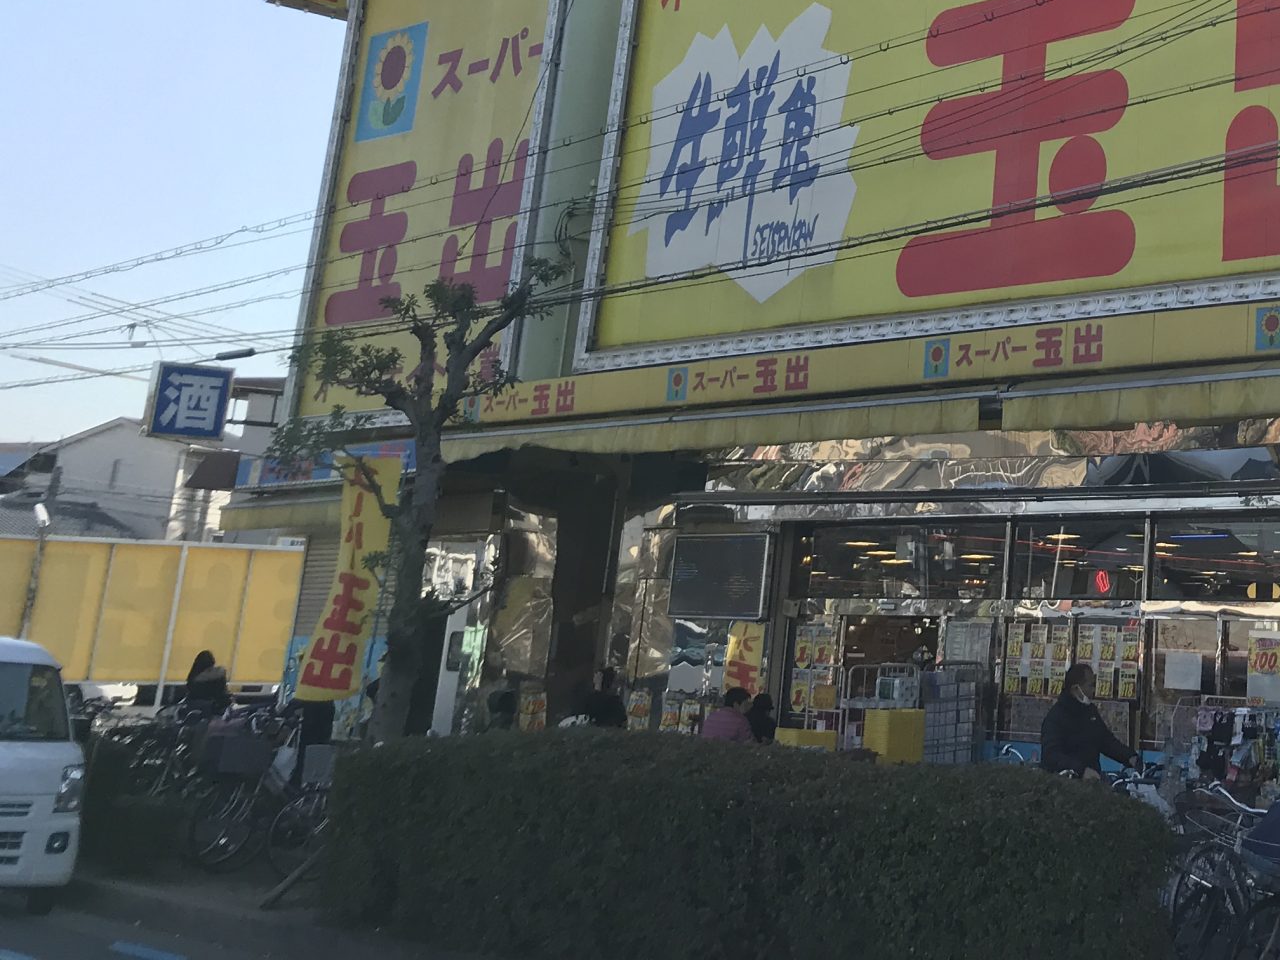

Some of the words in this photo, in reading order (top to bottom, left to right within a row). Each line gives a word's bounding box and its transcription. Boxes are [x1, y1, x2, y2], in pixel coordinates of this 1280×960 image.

[431, 26, 545, 100] スーパー
[325, 136, 531, 326] 玉出
[162, 371, 226, 432] 酒
[1253, 651, 1278, 670] 100
